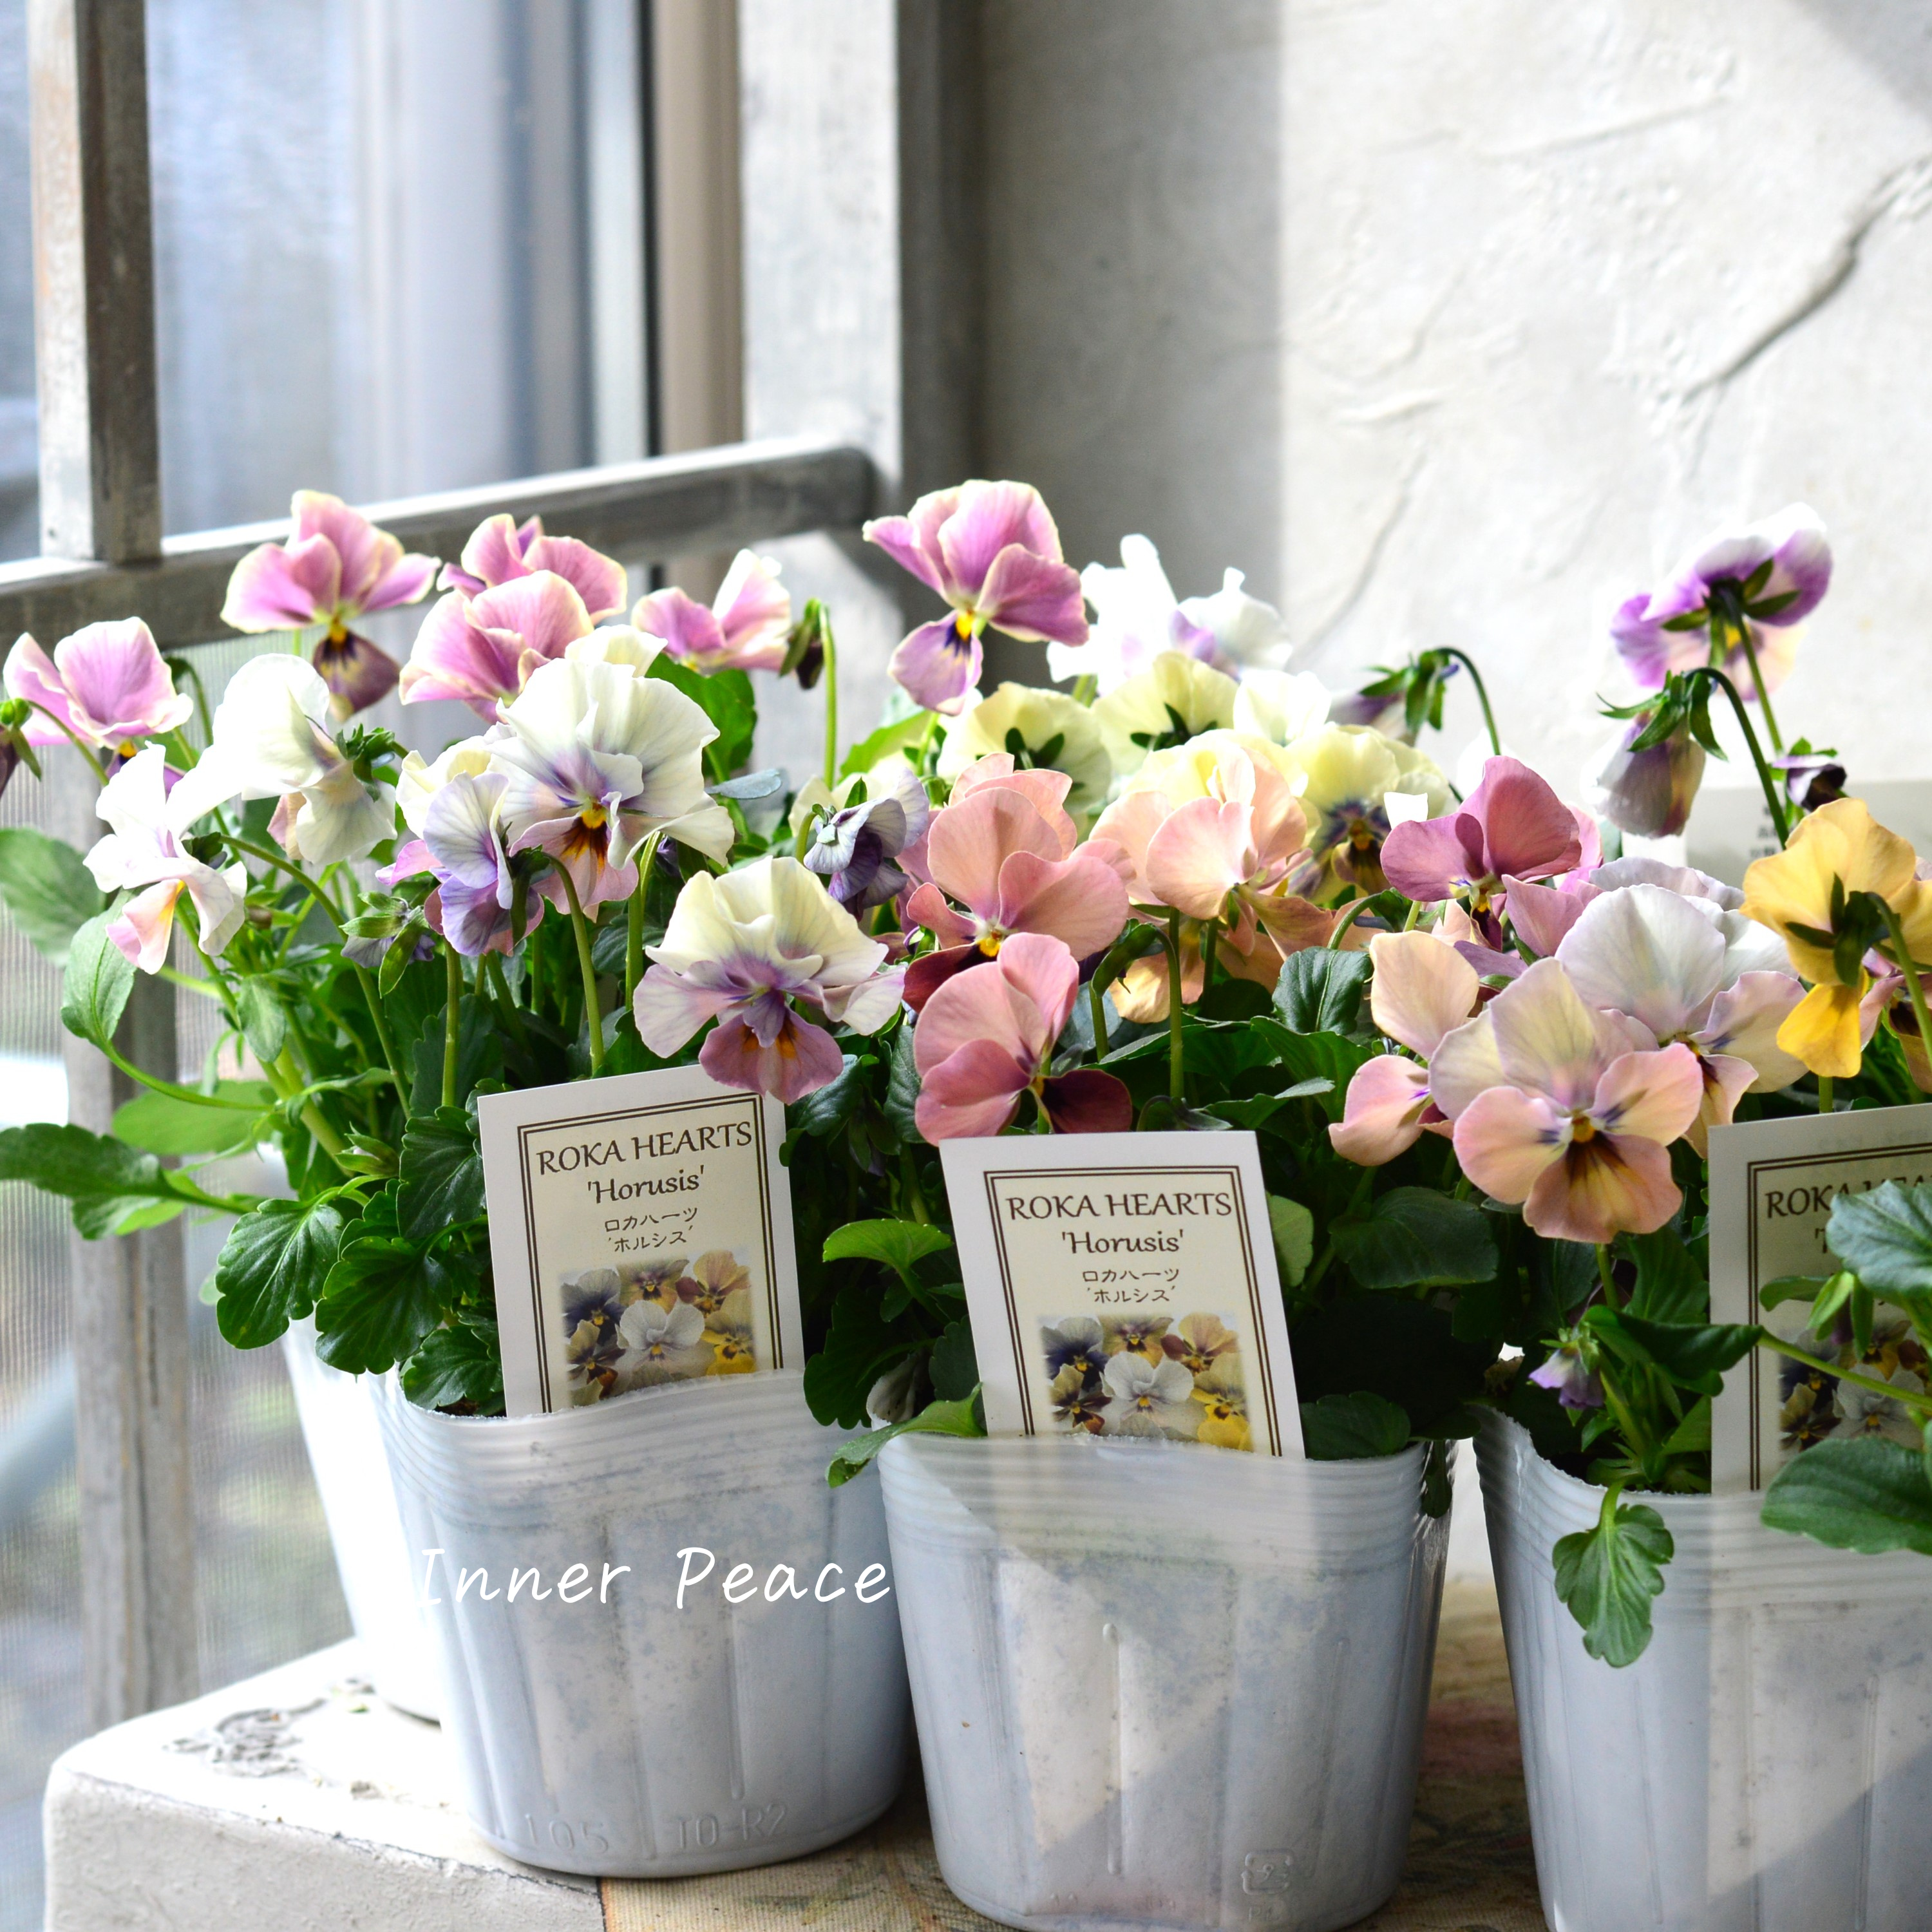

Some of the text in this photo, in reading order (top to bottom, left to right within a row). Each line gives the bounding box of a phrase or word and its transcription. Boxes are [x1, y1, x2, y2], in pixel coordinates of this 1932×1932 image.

[536, 1121, 752, 1175] ROKA HEARTS
[587, 1164, 705, 1204] 'Horusis'
[1005, 1193, 1232, 1220] ROKA HEARTS
[604, 1208, 698, 1233] ロカハーツ
[1062, 1229, 1184, 1254] 'Horusis'
[1082, 1269, 1179, 1283] ロカハーツ
